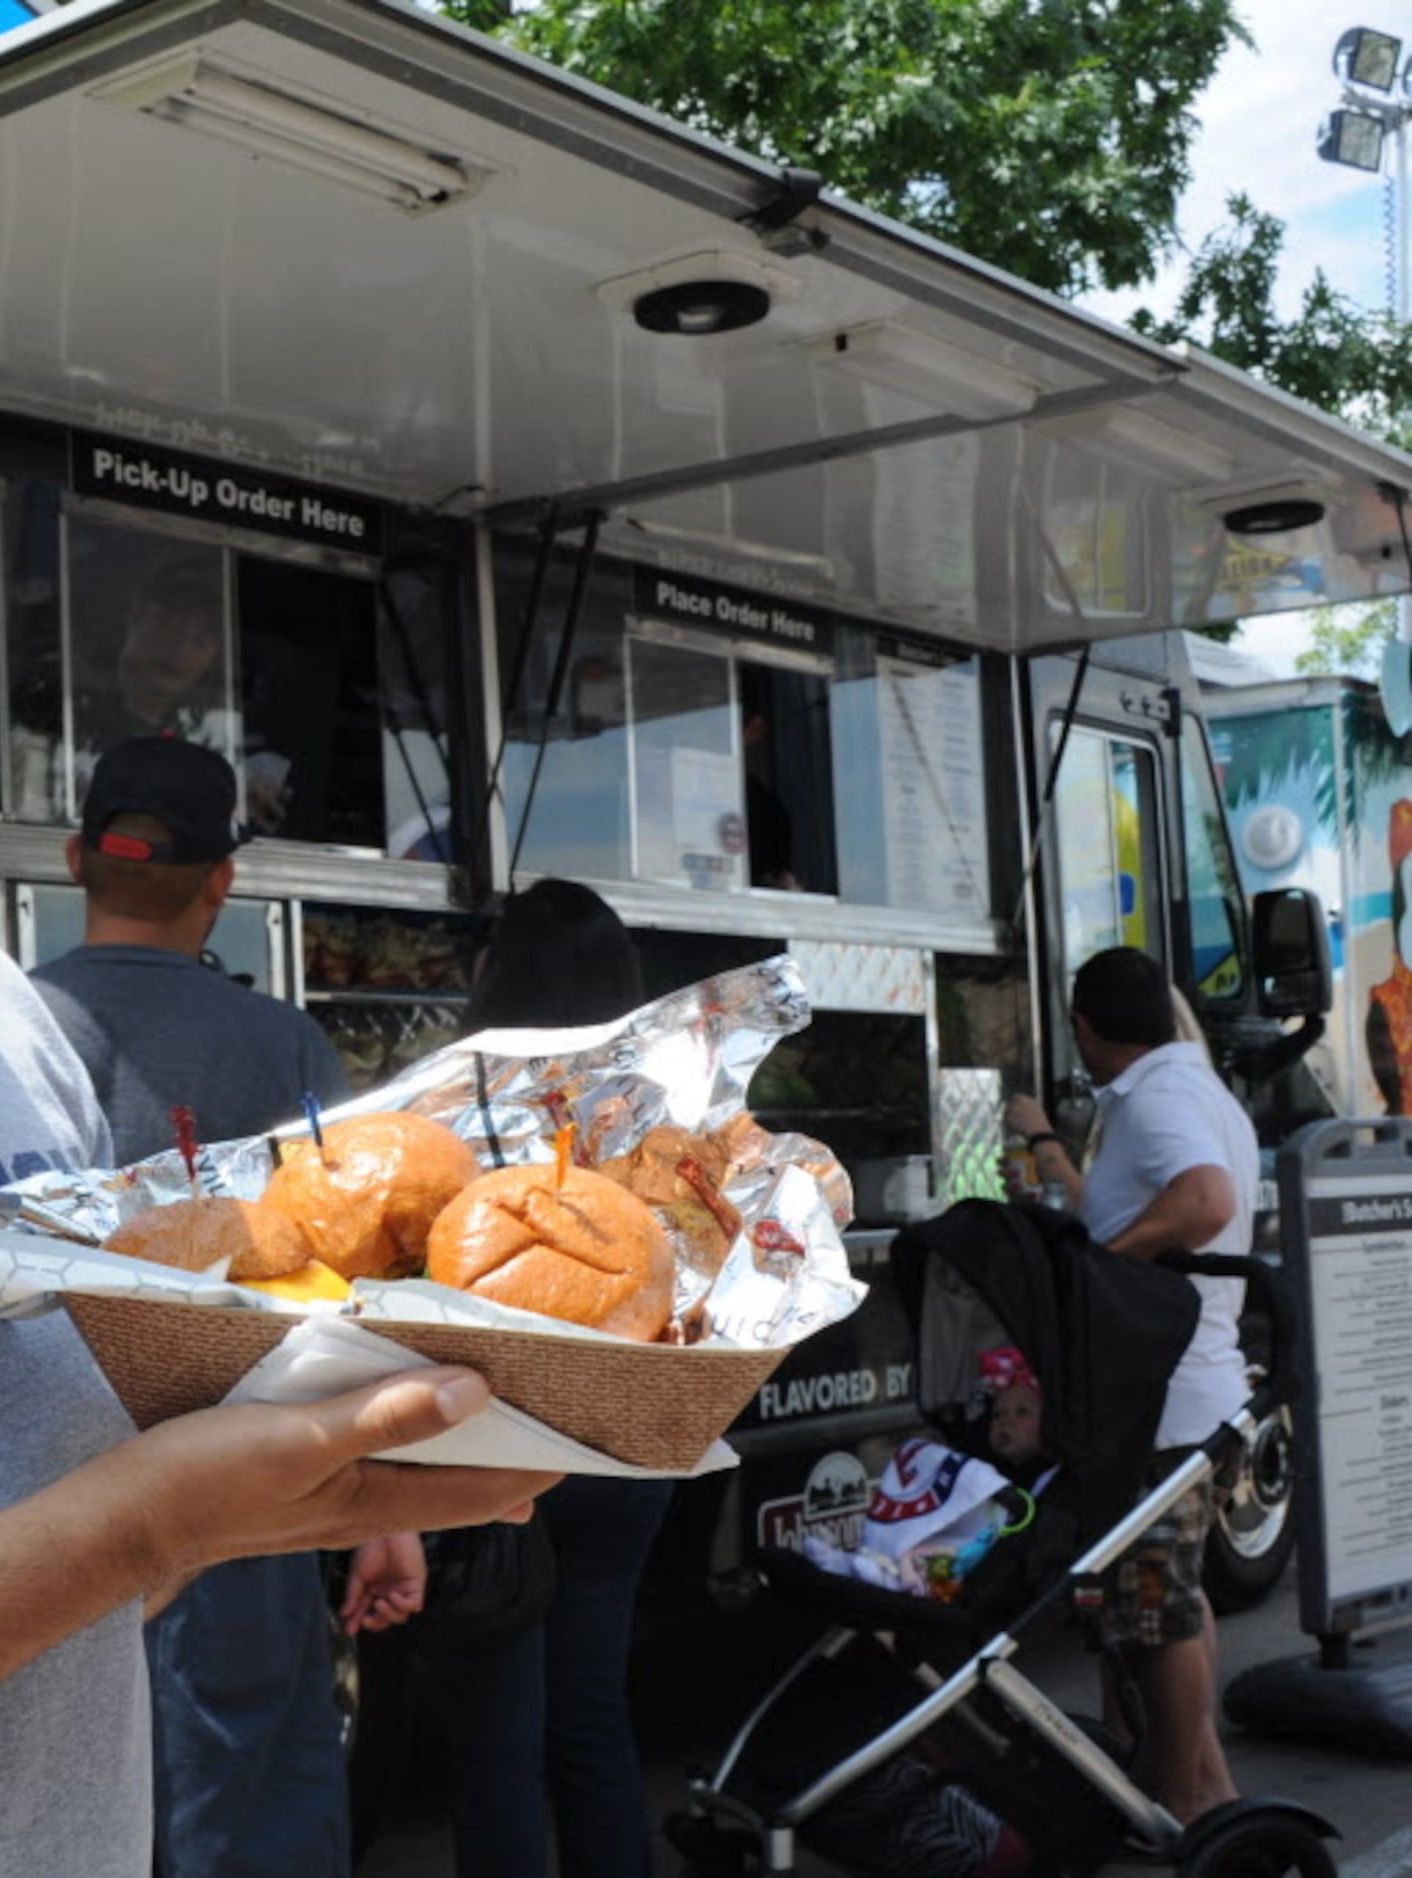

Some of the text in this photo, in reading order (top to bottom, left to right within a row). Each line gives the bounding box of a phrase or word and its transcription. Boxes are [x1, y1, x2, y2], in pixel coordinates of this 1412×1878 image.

[93, 448, 366, 537] Pick-Up Order Here
[656, 581, 815, 641] Place Order Here
[759, 1364, 912, 1420] FLAVORED BY
